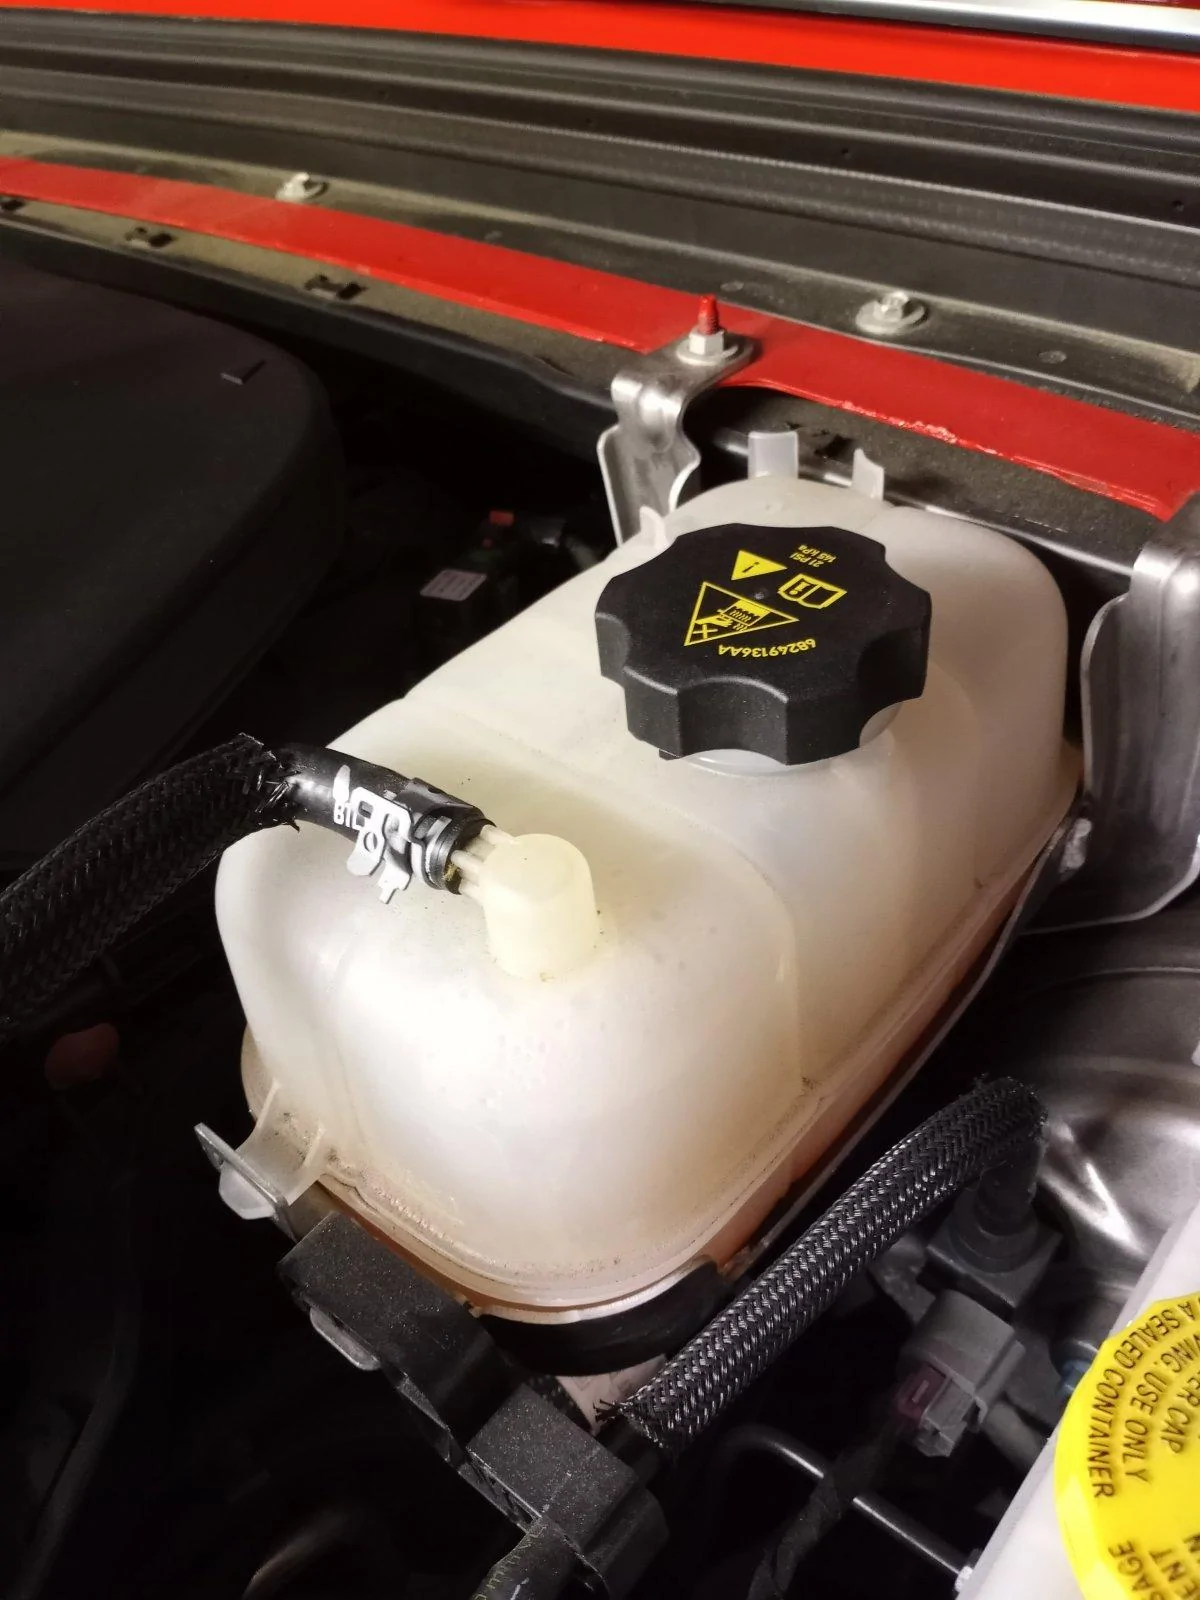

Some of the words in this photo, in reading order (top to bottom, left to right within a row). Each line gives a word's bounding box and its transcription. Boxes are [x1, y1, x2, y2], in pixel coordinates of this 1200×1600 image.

[790, 552, 811, 563] PSI
[798, 545, 819, 558] kPa
[811, 557, 825, 568] 21
[1177, 1301, 1196, 1321] A
[1113, 1309, 1180, 1369] SEALED
[1129, 1372, 1168, 1415] USE
[1087, 1368, 1124, 1498] CONTAINER
[1122, 1420, 1149, 1482] ONLY
[1159, 1407, 1192, 1454] CAP
